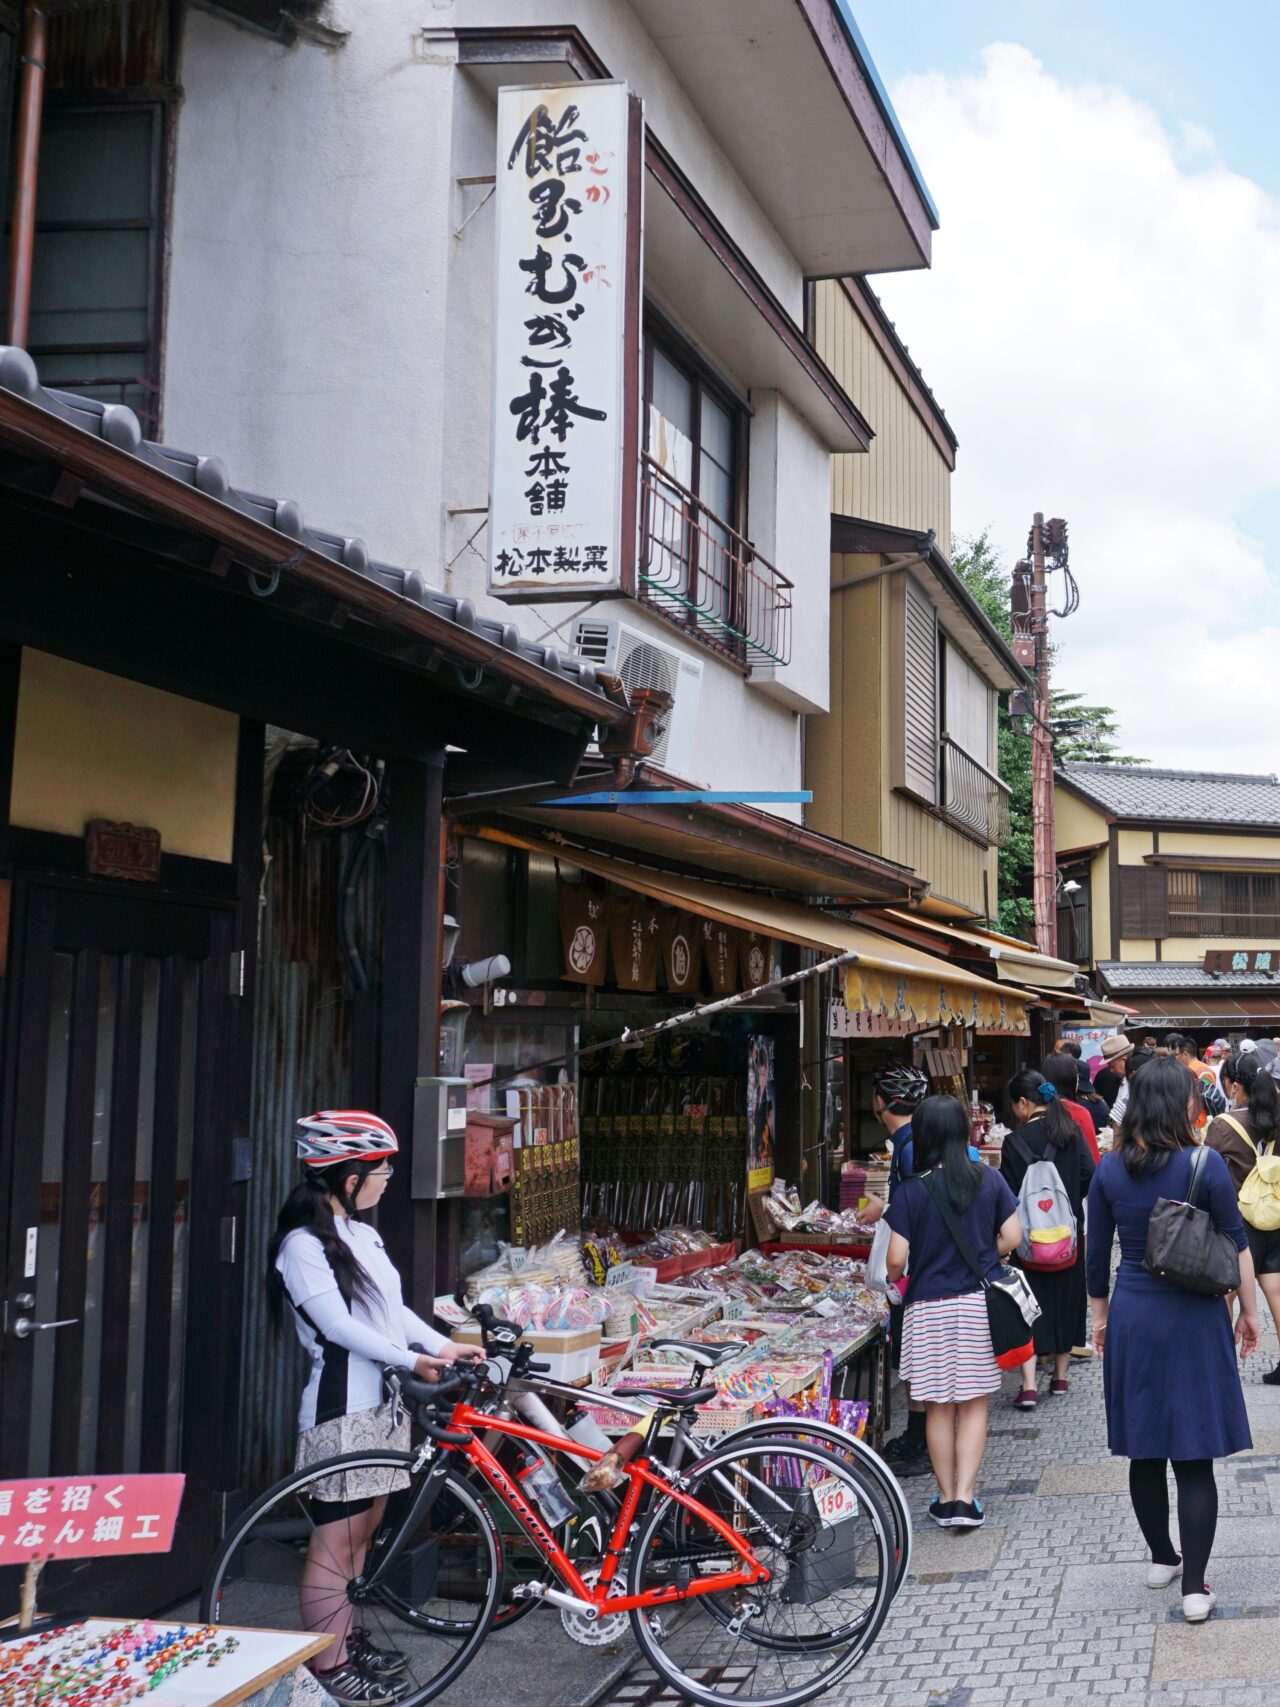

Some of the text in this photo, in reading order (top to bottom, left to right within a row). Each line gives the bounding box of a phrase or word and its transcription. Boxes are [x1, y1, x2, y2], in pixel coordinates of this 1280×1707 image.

[494, 545, 608, 577] 松本製菓
[480, 1460, 557, 1554] ANCHOR
[0, 1514, 161, 1548] なん細工
